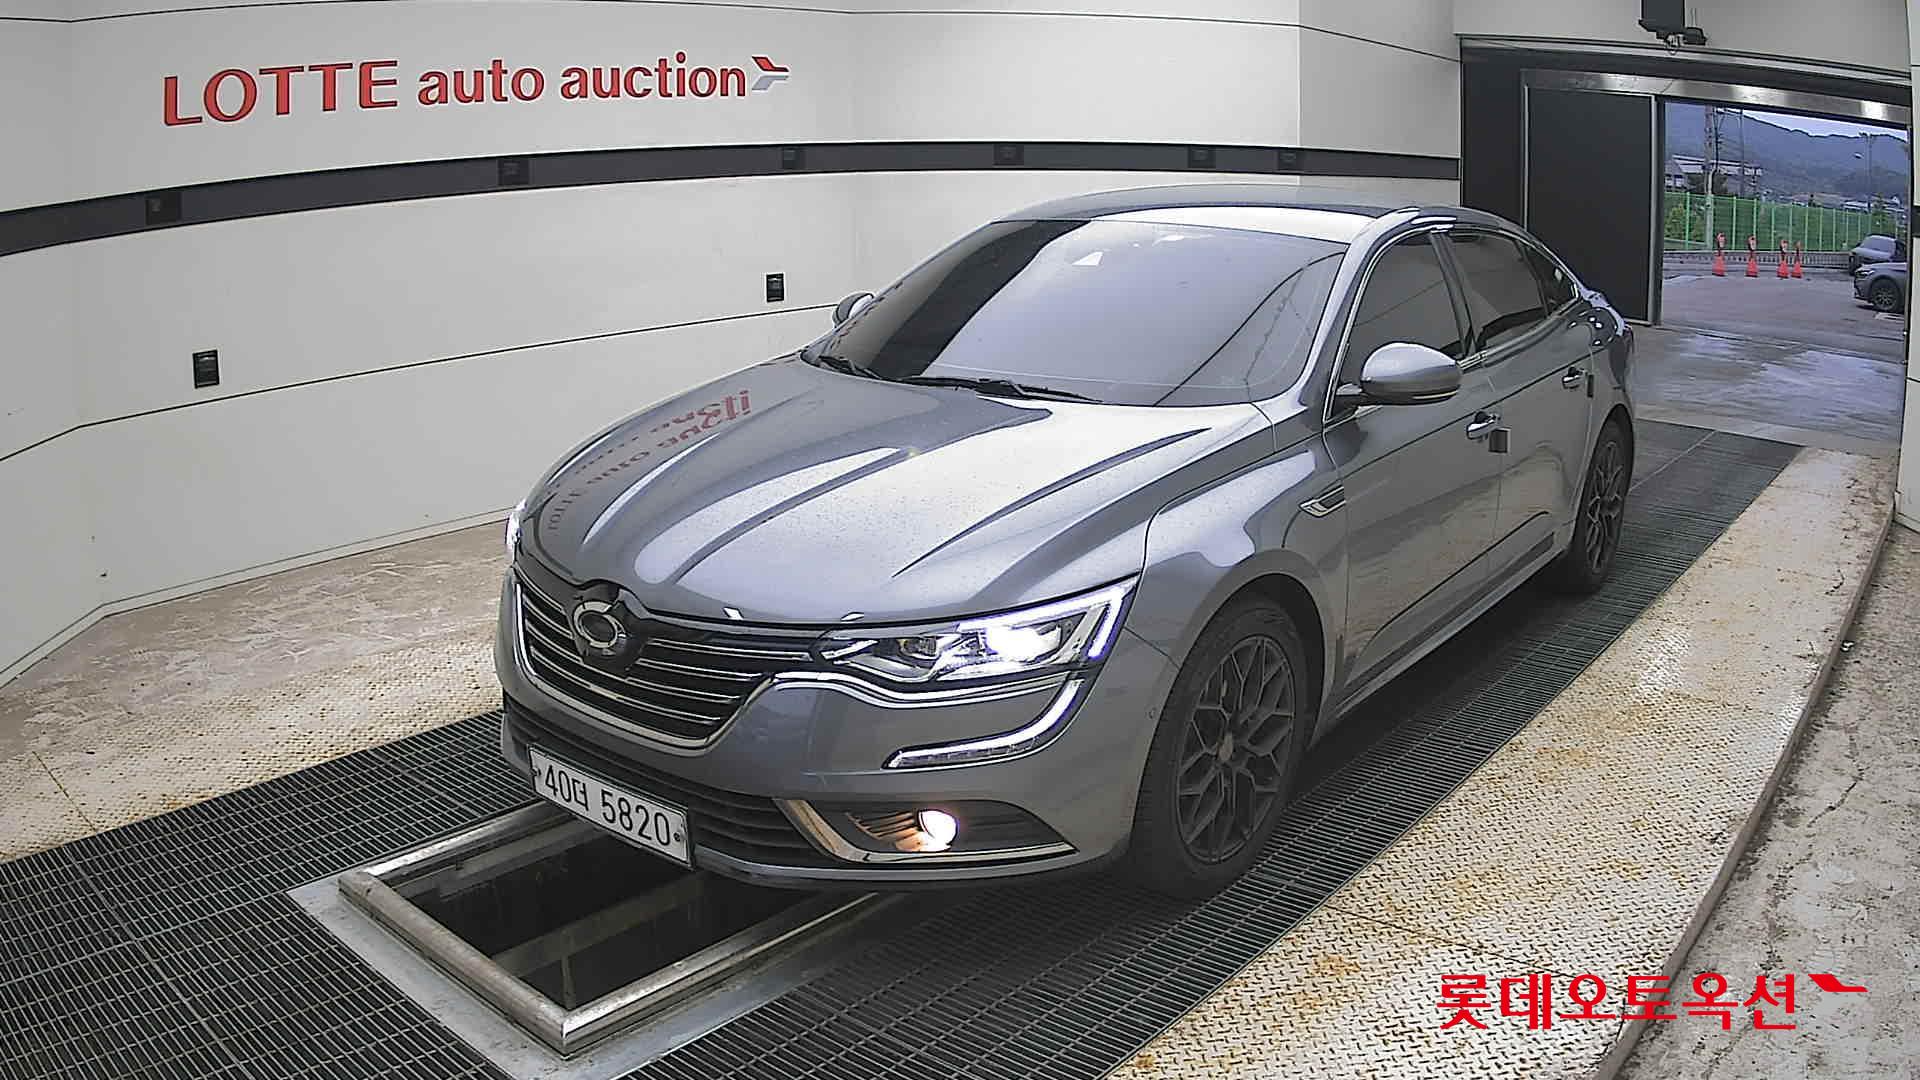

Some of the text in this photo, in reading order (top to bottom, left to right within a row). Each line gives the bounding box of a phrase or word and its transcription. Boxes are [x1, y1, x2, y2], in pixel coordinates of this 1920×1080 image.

[163, 52, 746, 125] LOTTE auto auction
[545, 765, 671, 846] 40더 5820
